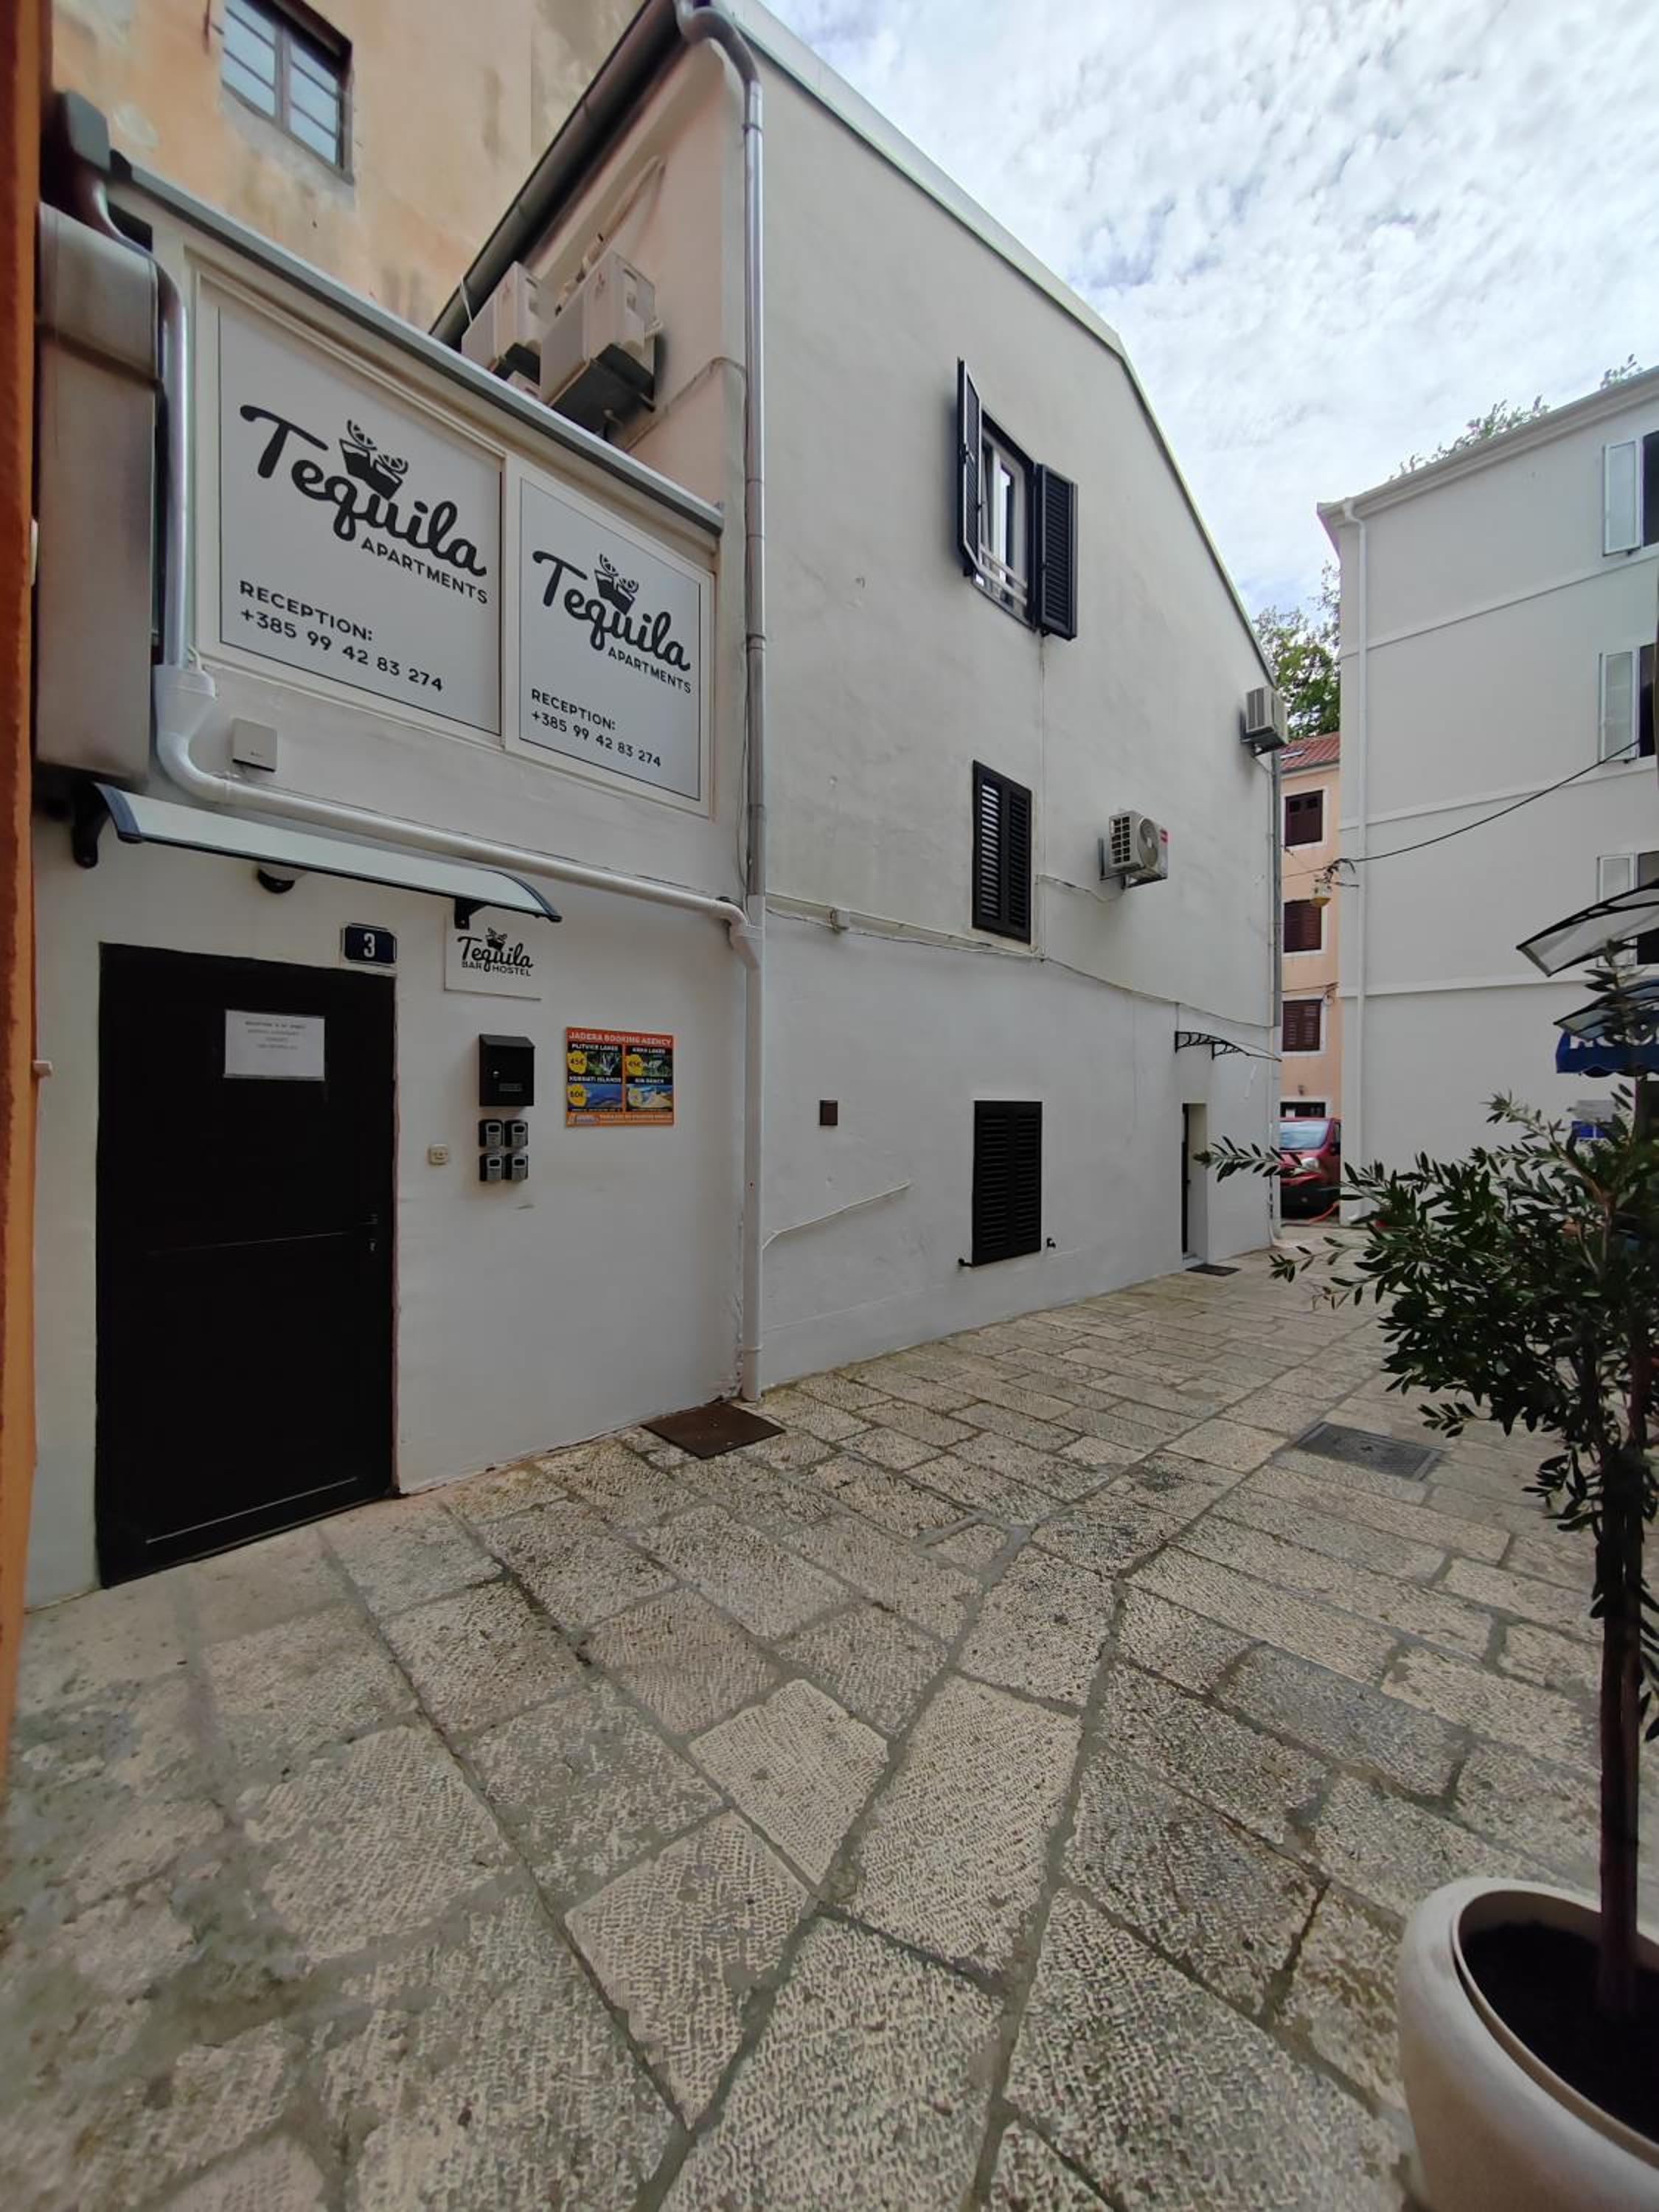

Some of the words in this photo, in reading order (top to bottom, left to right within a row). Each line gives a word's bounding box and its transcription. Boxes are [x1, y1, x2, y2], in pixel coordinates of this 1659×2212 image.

[240, 405, 487, 577] Tequila
[361, 537, 488, 604] APARTMENTS
[240, 580, 373, 641] RECEPTION:
[532, 551, 691, 671] Tequila
[240, 608, 297, 639] +385
[307, 630, 332, 650] 99
[342, 646, 369, 664] 42
[377, 657, 400, 676] 83
[408, 668, 442, 692] 274
[608, 647, 692, 693] APARTMENTS
[531, 688, 616, 730] RECEPTION:
[532, 711, 567, 732] +385
[573, 725, 589, 740] 99
[596, 734, 613, 750] 42
[617, 742, 633, 757] 83
[638, 750, 661, 767] 274
[364, 933, 375, 958] 3
[456, 936, 534, 973] Tequila
[462, 961, 481, 970] BAR
[492, 964, 531, 977] HOSTEL
[641, 1037, 672, 1046] AGENCY
